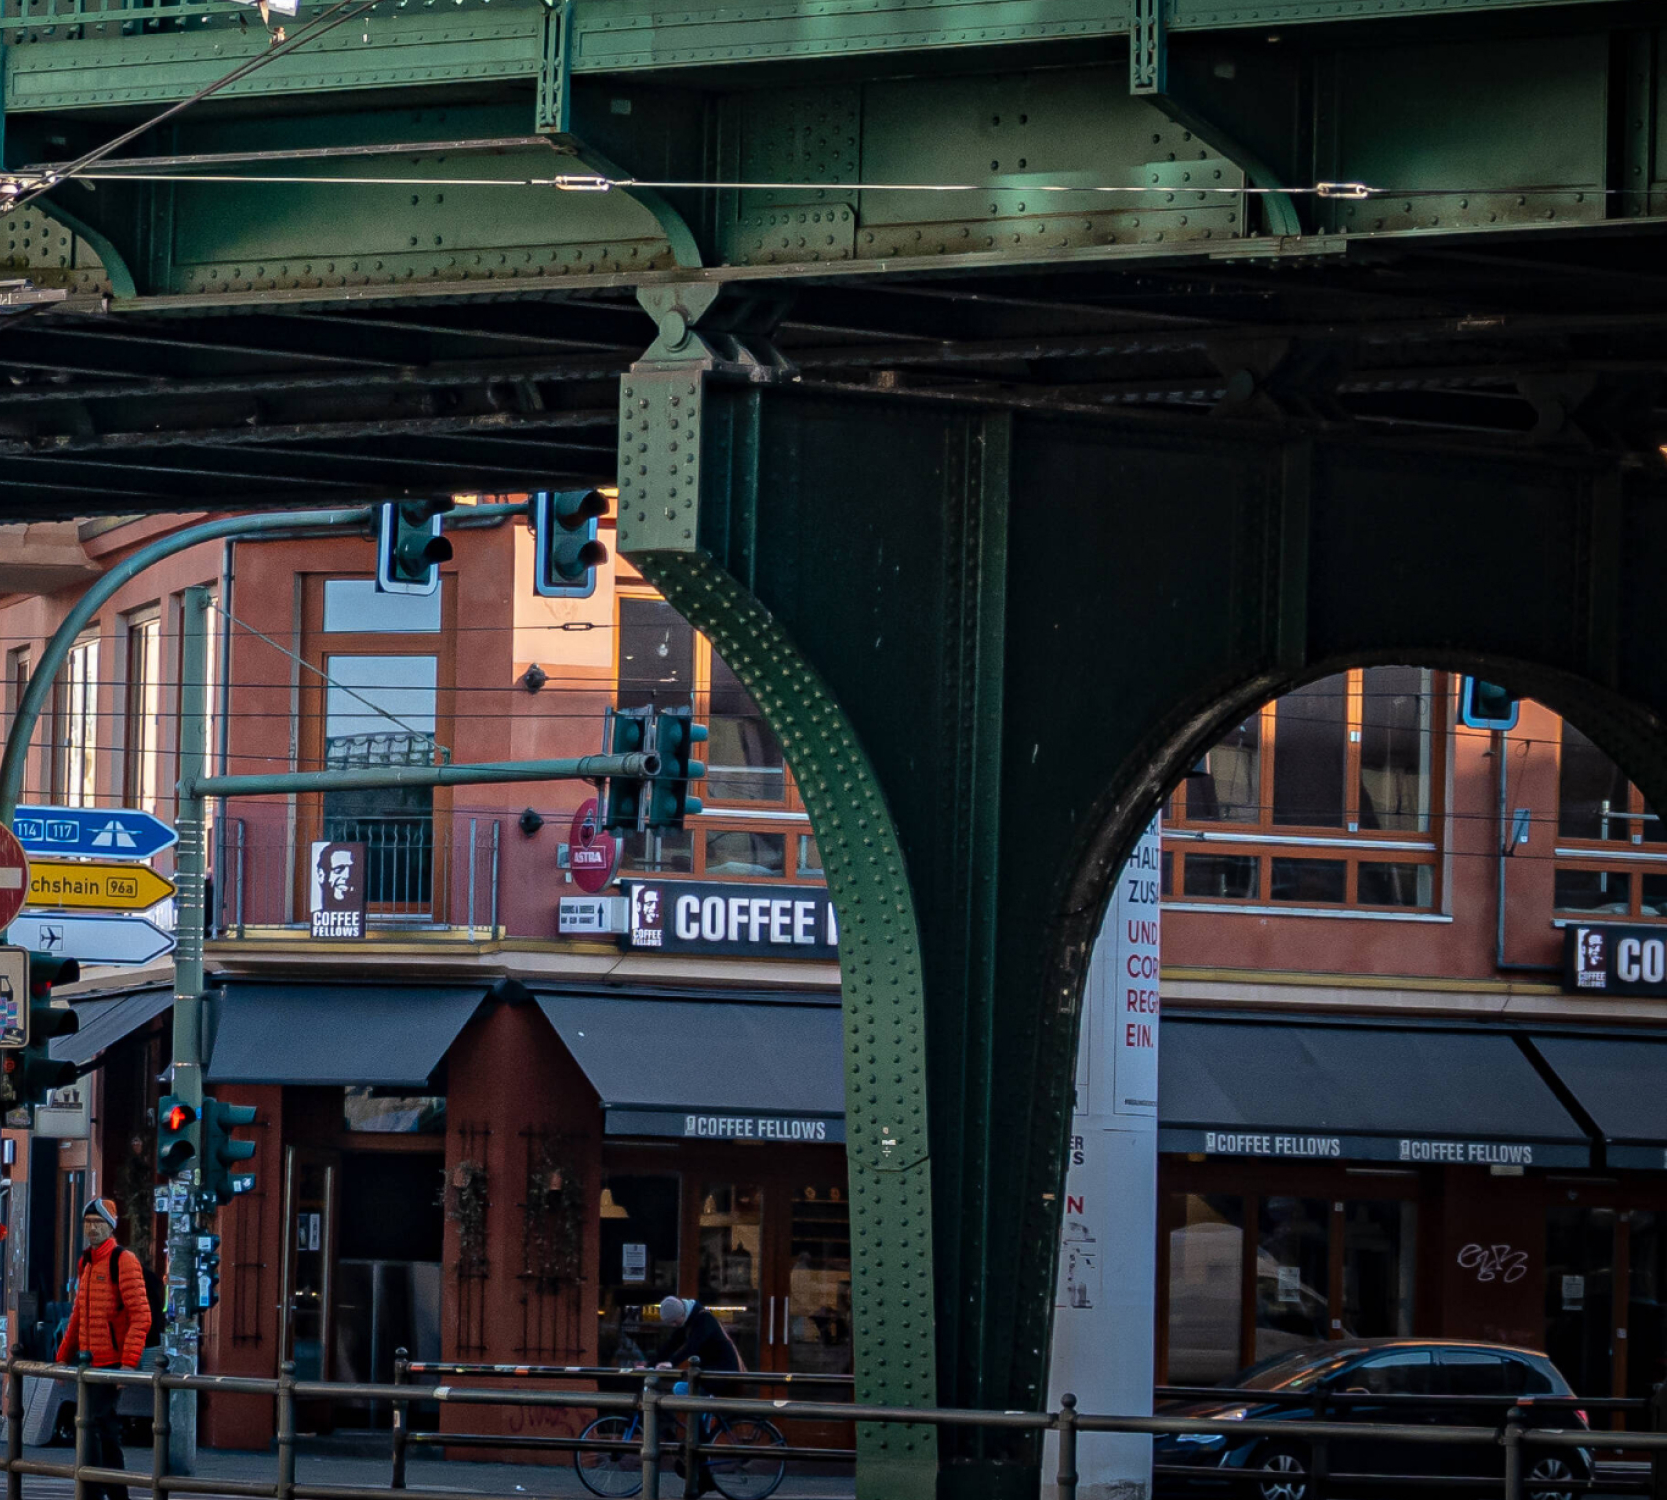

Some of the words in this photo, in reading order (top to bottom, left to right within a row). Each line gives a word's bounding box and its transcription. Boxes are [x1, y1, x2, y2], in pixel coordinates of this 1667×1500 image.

[17, 823, 37, 837] 114
[53, 824, 72, 837] 117
[573, 851, 603, 863] ASTRA
[30, 876, 100, 895] chshain
[110, 880, 134, 895] 96a
[313, 911, 360, 926] COFFEE
[675, 894, 816, 945] COFFEE
[313, 926, 360, 937] FELLOWS
[632, 929, 663, 940] COFFEE
[1617, 938, 1667, 983] CO
[1125, 1023, 1154, 1048] EIN.
[698, 1116, 753, 1137] COFFEE
[758, 1119, 826, 1140] FELLOWS
[1217, 1134, 1271, 1153] COFFEE
[1275, 1136, 1341, 1156] FELLOWS
[1412, 1142, 1465, 1161] COFFEE
[1468, 1144, 1533, 1164] FELLOWS
